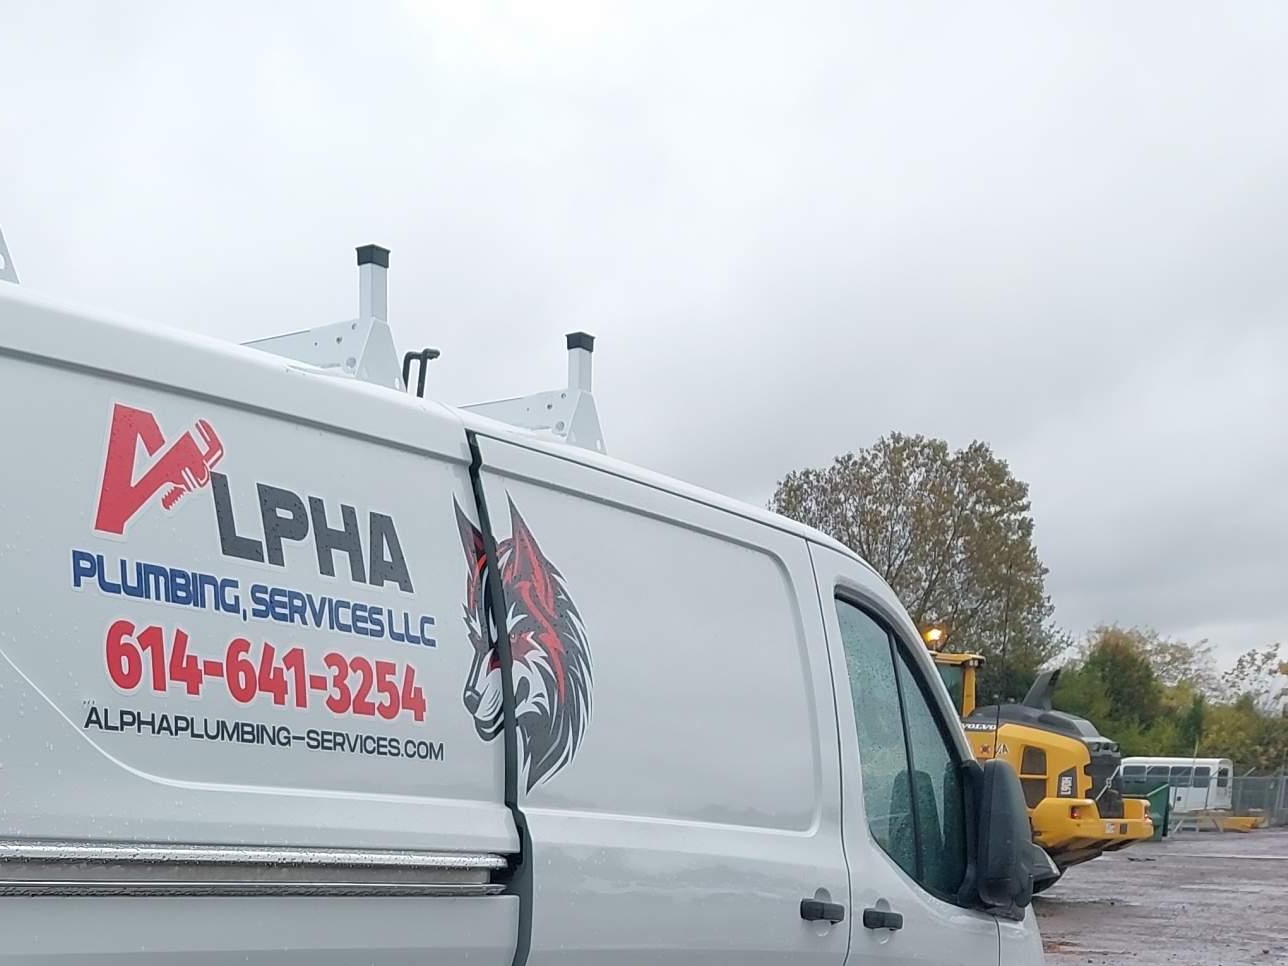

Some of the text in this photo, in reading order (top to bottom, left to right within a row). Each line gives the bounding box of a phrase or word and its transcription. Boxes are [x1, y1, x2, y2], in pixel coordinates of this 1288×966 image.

[72, 550, 436, 647] PLUMBING, SERVICES LLC
[106, 619, 426, 722] 614-641-3254
[84, 706, 445, 761] ALPHAPLUMBING-SERVICES.COM
